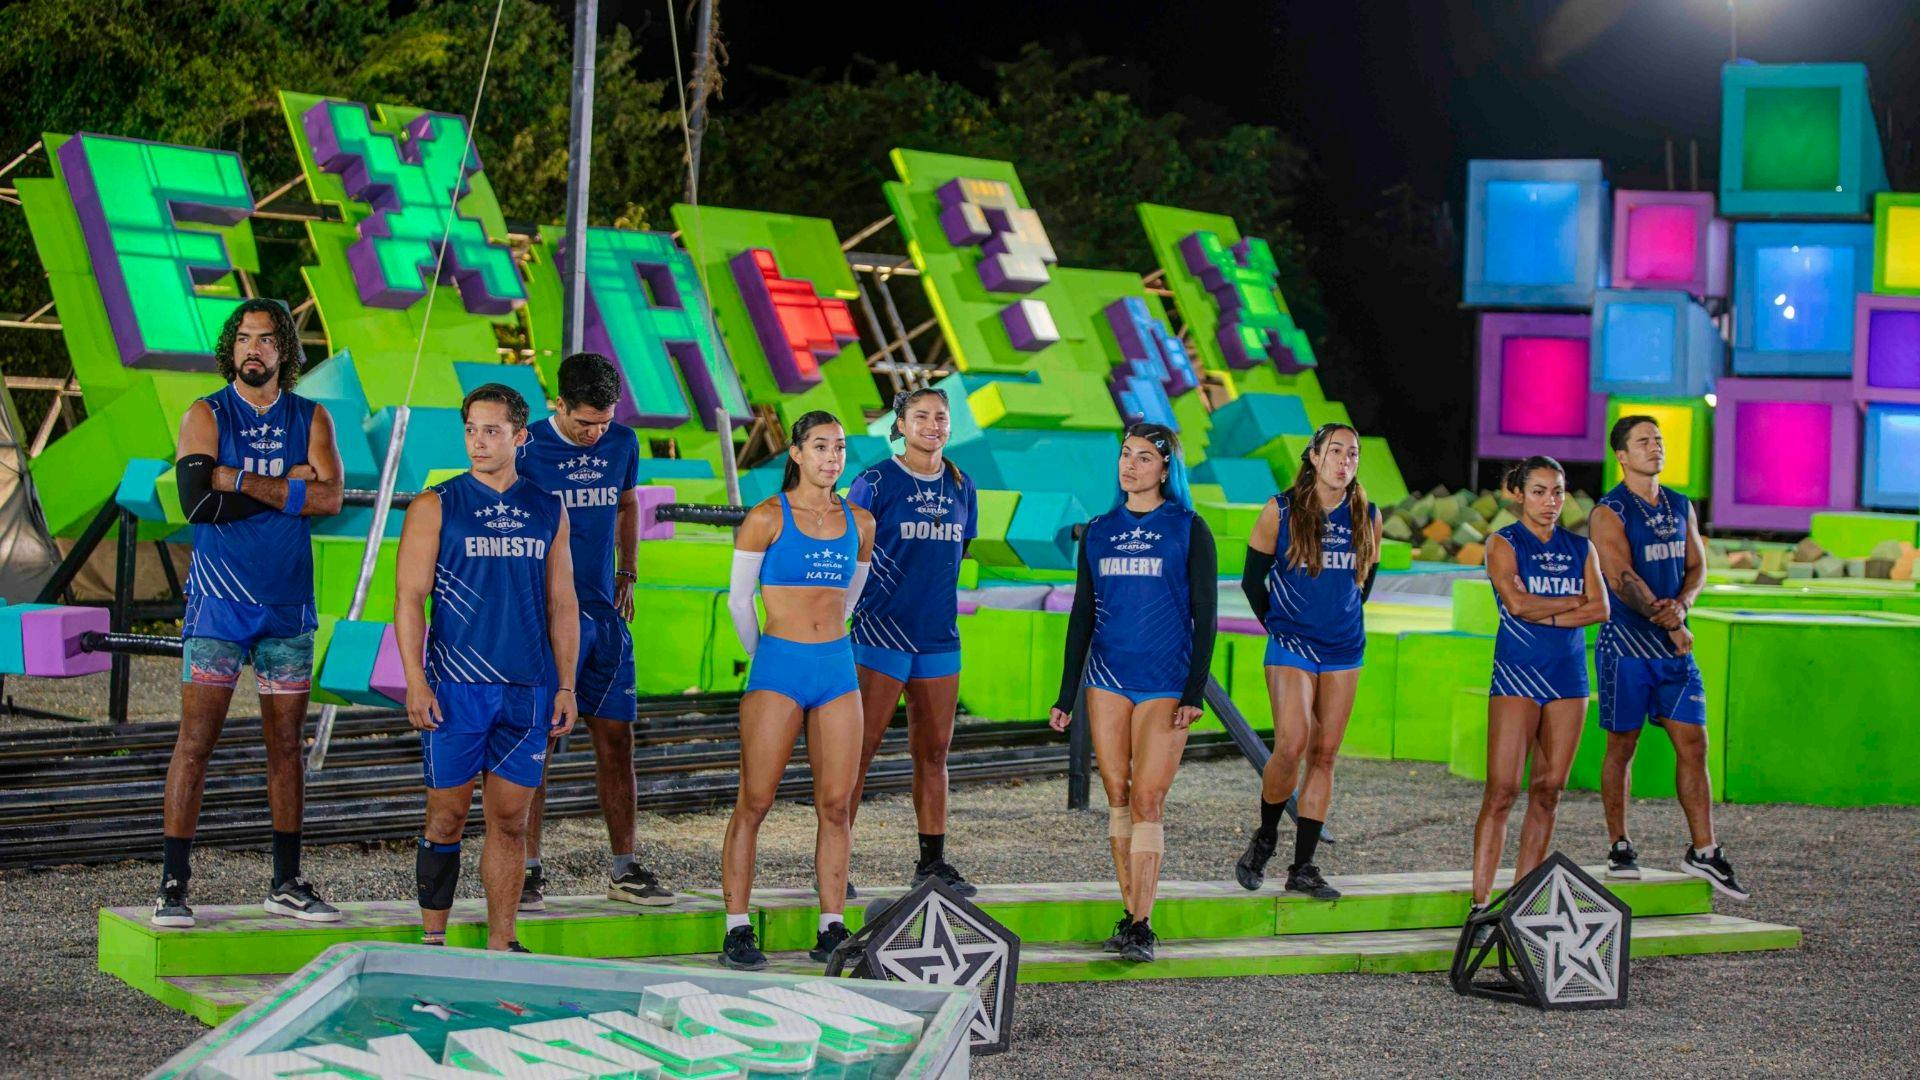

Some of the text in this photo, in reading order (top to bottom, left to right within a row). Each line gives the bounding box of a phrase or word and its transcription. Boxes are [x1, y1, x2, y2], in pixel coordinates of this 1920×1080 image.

[243, 456, 284, 477] LEO
[900, 521, 963, 542] DORIS
[464, 536, 546, 560] ERNESTO
[806, 571, 842, 581] KATIA
[1099, 556, 1163, 577] VALERY
